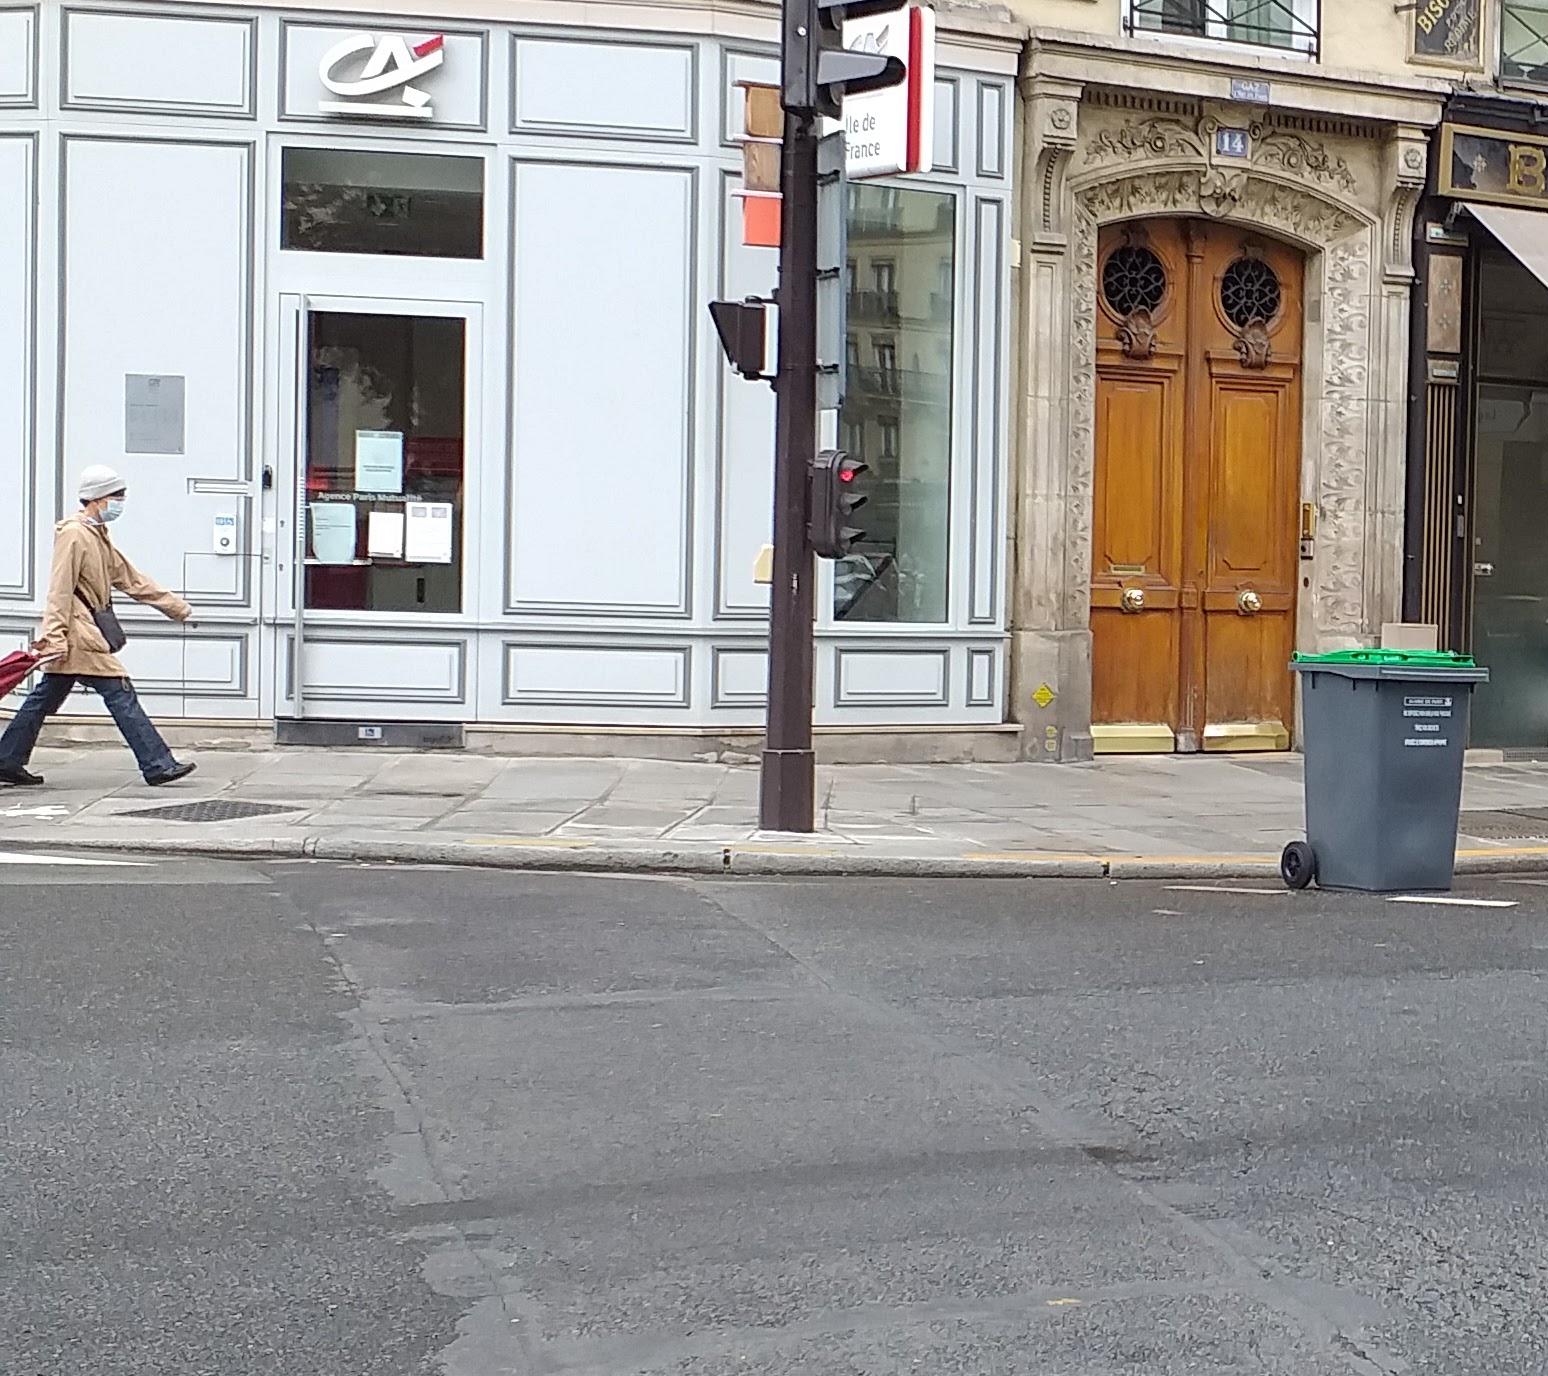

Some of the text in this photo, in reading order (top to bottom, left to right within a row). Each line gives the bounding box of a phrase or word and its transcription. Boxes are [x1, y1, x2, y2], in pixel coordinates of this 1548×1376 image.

[862, 112, 876, 131] de
[1222, 132, 1244, 153] 14
[317, 491, 351, 502] Agence
[353, 492, 377, 502] Paris
